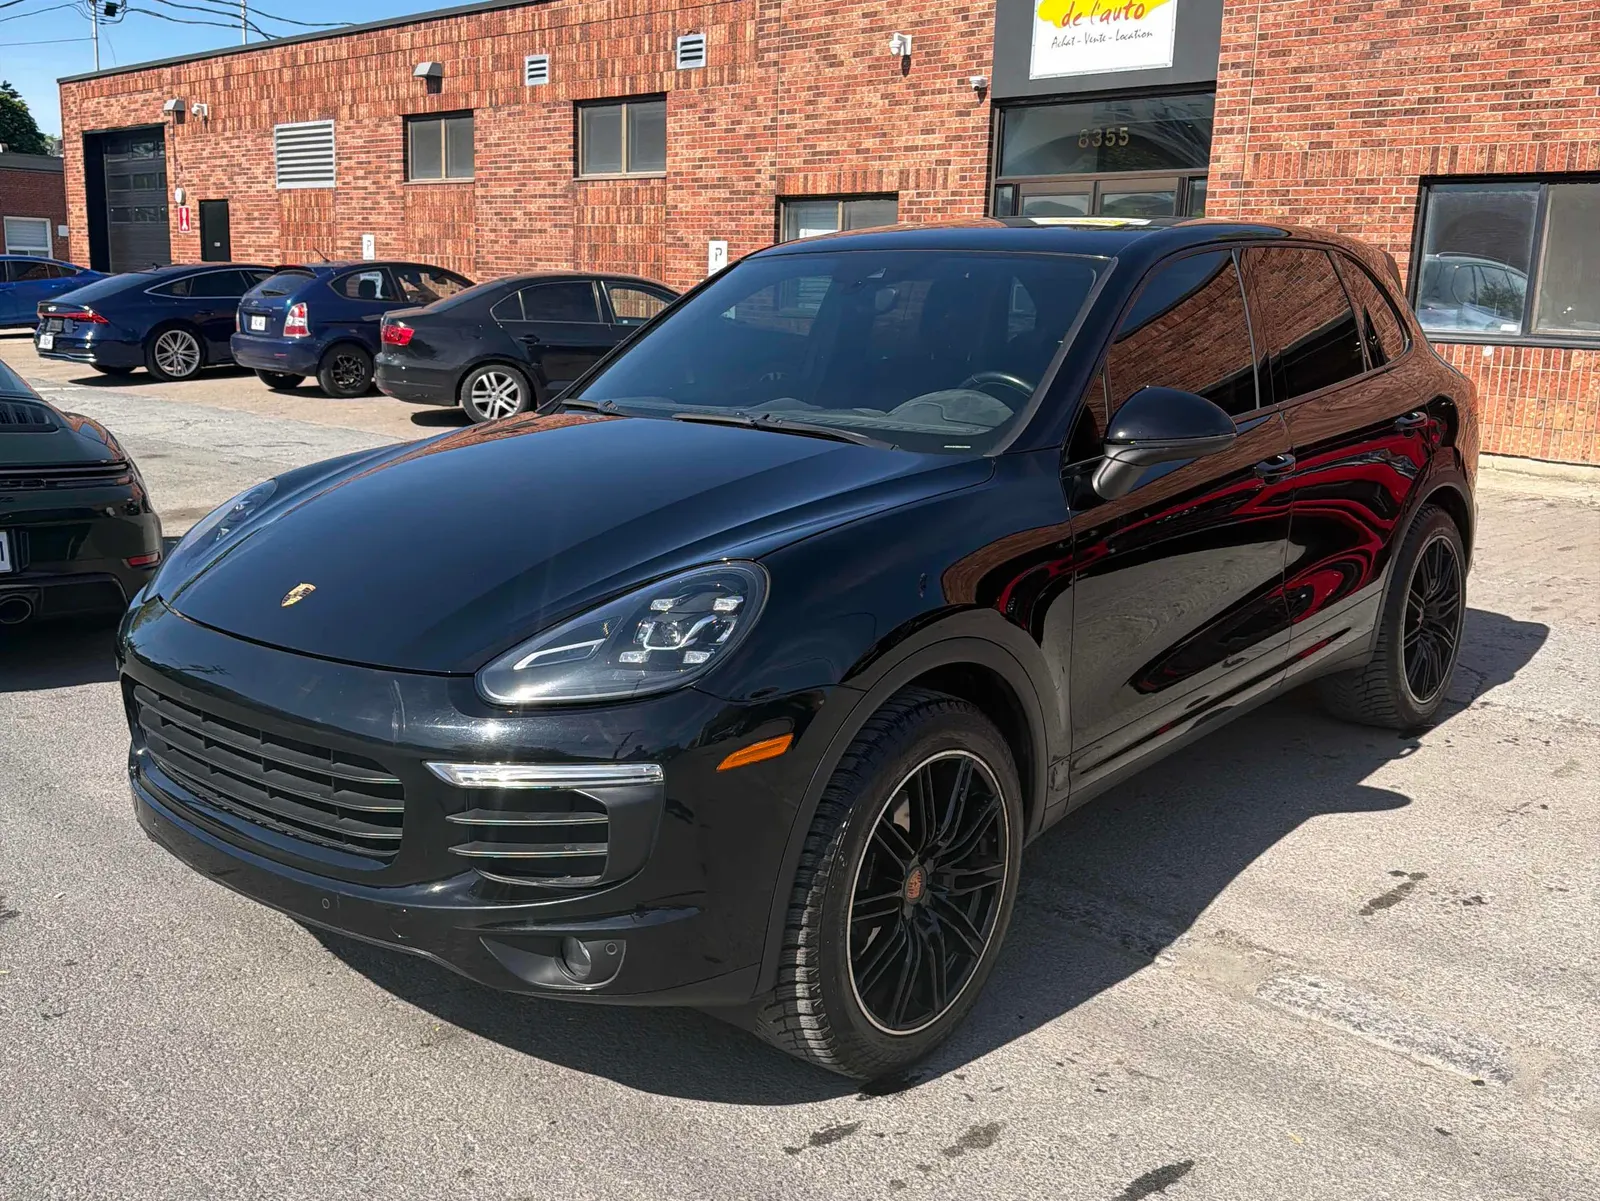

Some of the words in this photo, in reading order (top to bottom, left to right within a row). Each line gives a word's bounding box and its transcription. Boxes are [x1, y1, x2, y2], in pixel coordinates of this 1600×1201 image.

[1061, 0, 1082, 28] de
[1090, 0, 1145, 25] l'auto
[1051, 35, 1075, 48] Achat
[1084, 32, 1106, 45] Vente
[1115, 28, 1153, 42] Location
[1078, 127, 1130, 149] 8355
